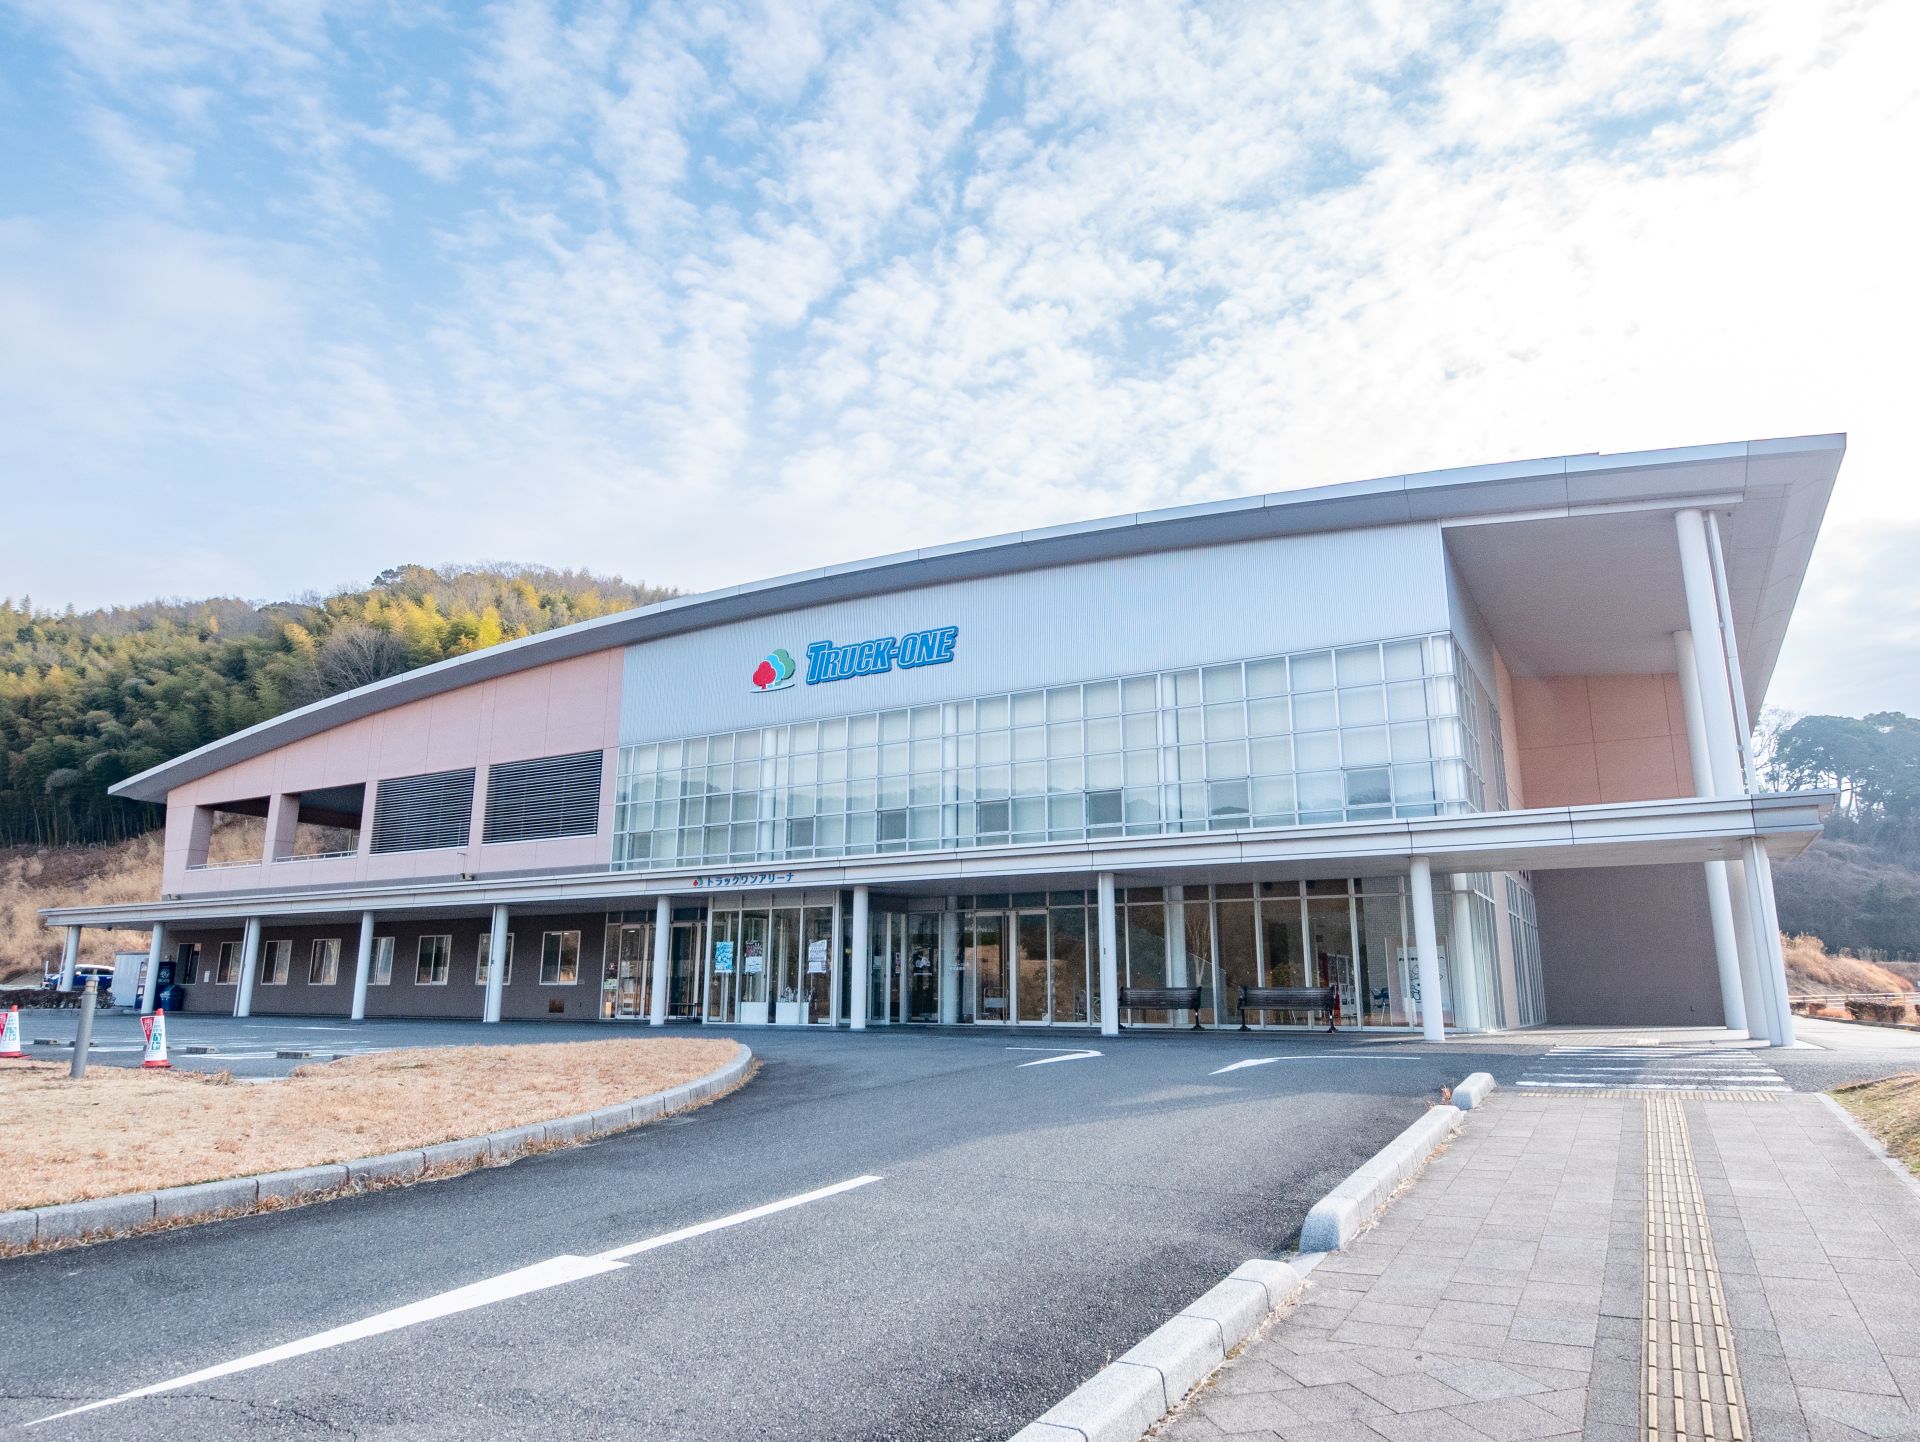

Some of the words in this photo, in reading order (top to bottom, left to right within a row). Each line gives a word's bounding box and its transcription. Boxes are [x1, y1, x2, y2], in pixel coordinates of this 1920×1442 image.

[806, 626, 959, 685] TRUCK-ONE
[707, 872, 794, 887] トラックワンアリーナ
